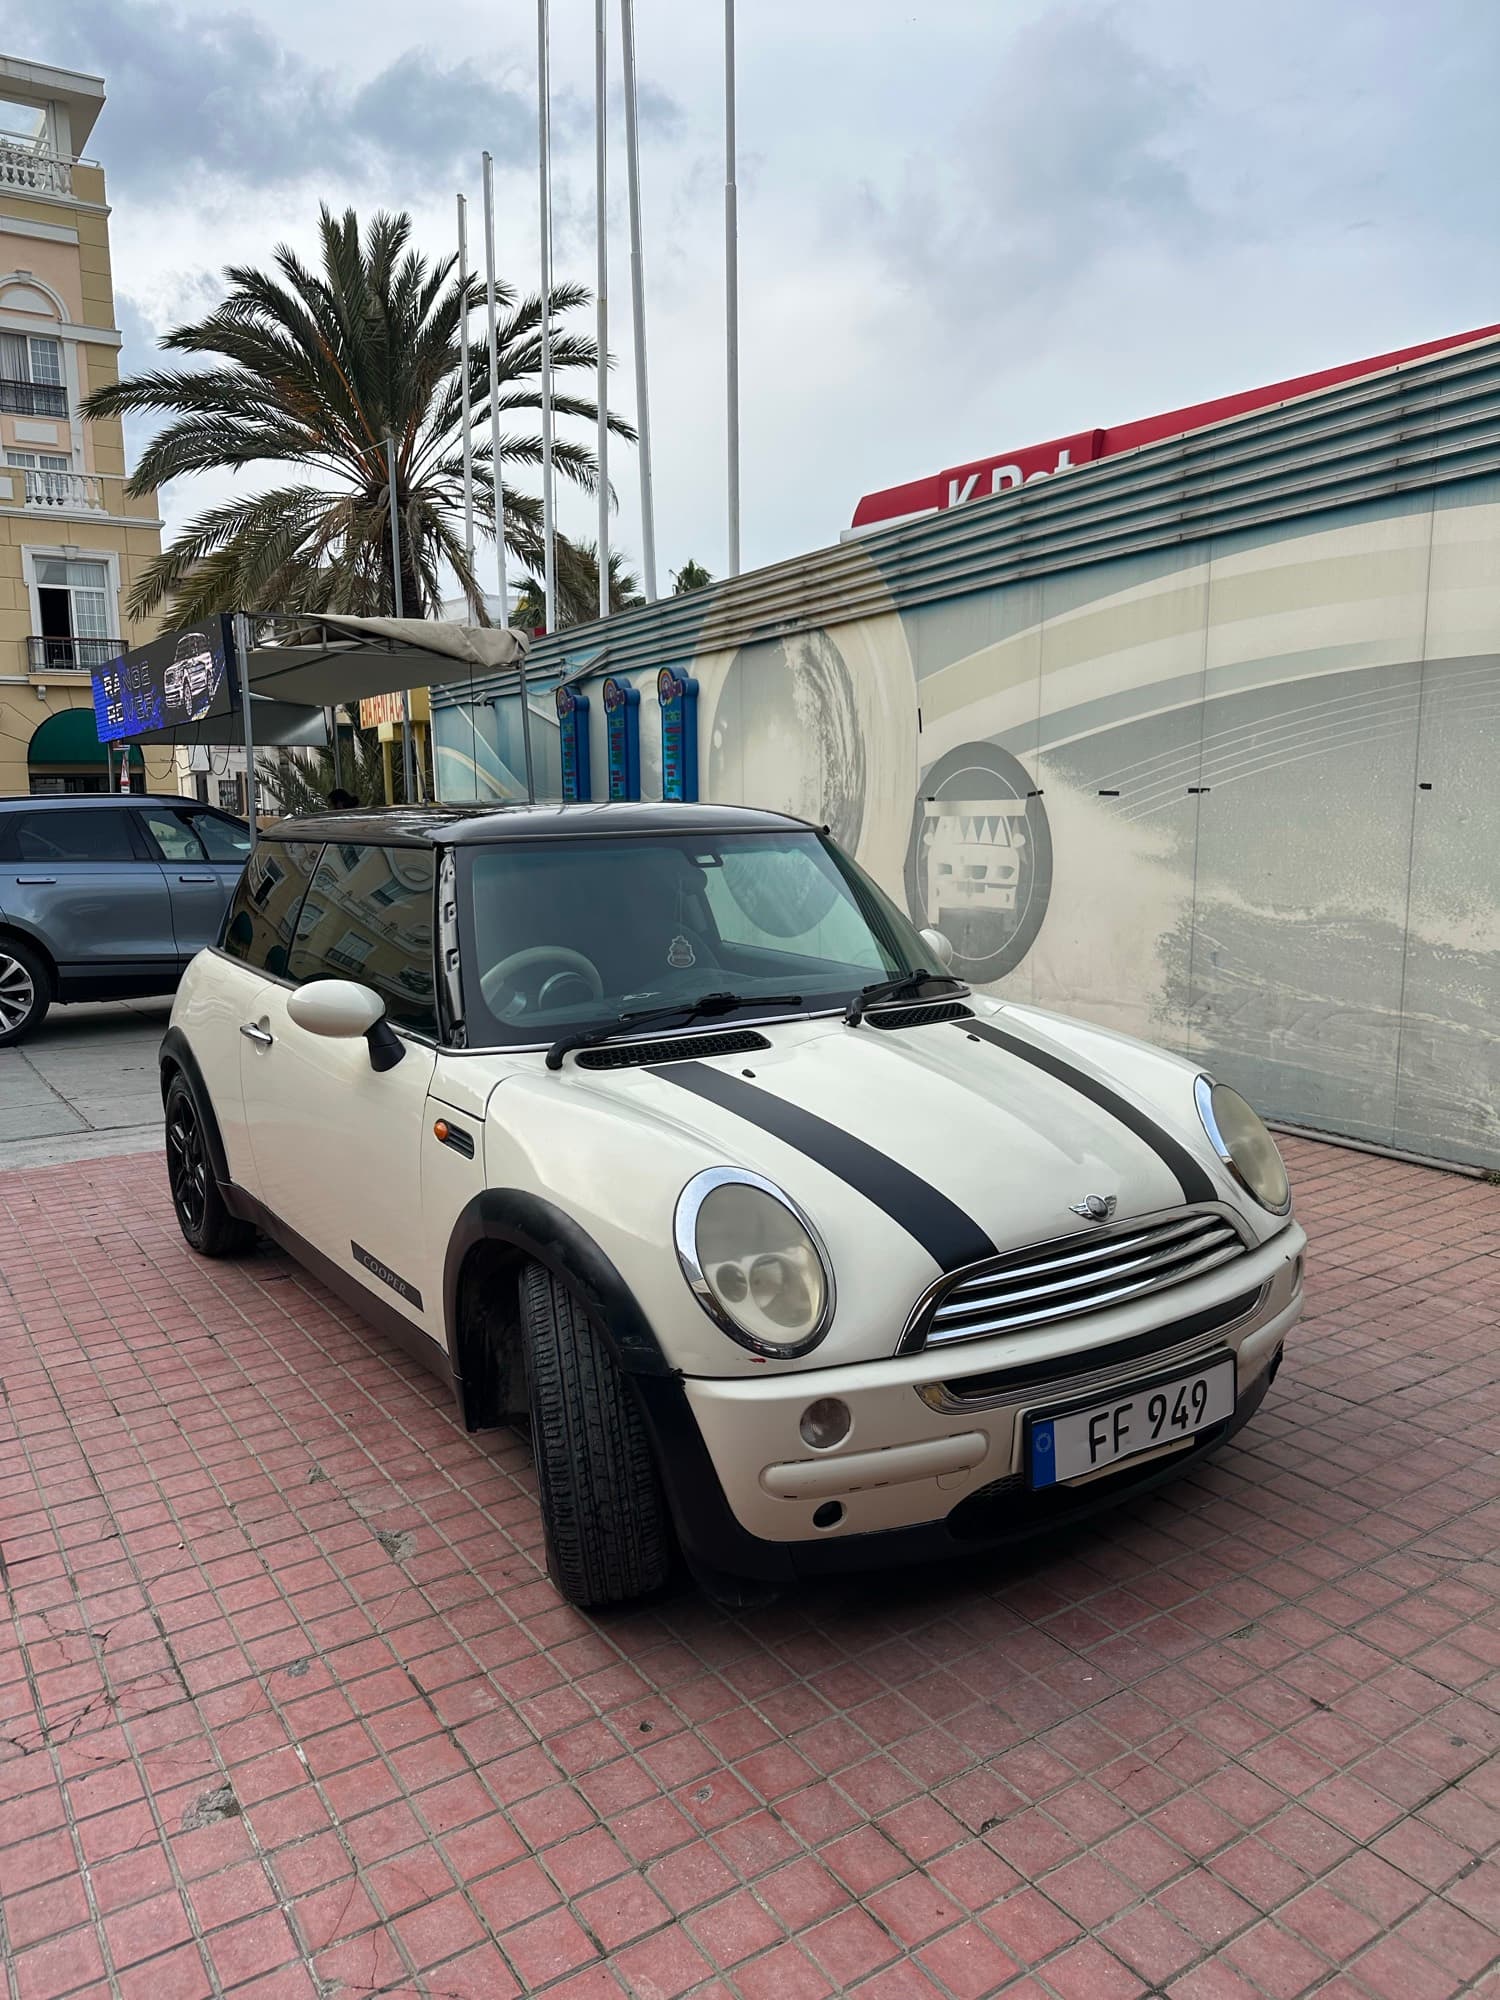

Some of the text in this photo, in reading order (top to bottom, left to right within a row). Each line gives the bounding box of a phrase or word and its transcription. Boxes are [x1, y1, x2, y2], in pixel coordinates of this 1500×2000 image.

[103, 660, 151, 698] RANGE
[106, 692, 155, 725] ROVER
[363, 1255, 406, 1296] COOPER
[1089, 1379, 1208, 1464] FF 949
